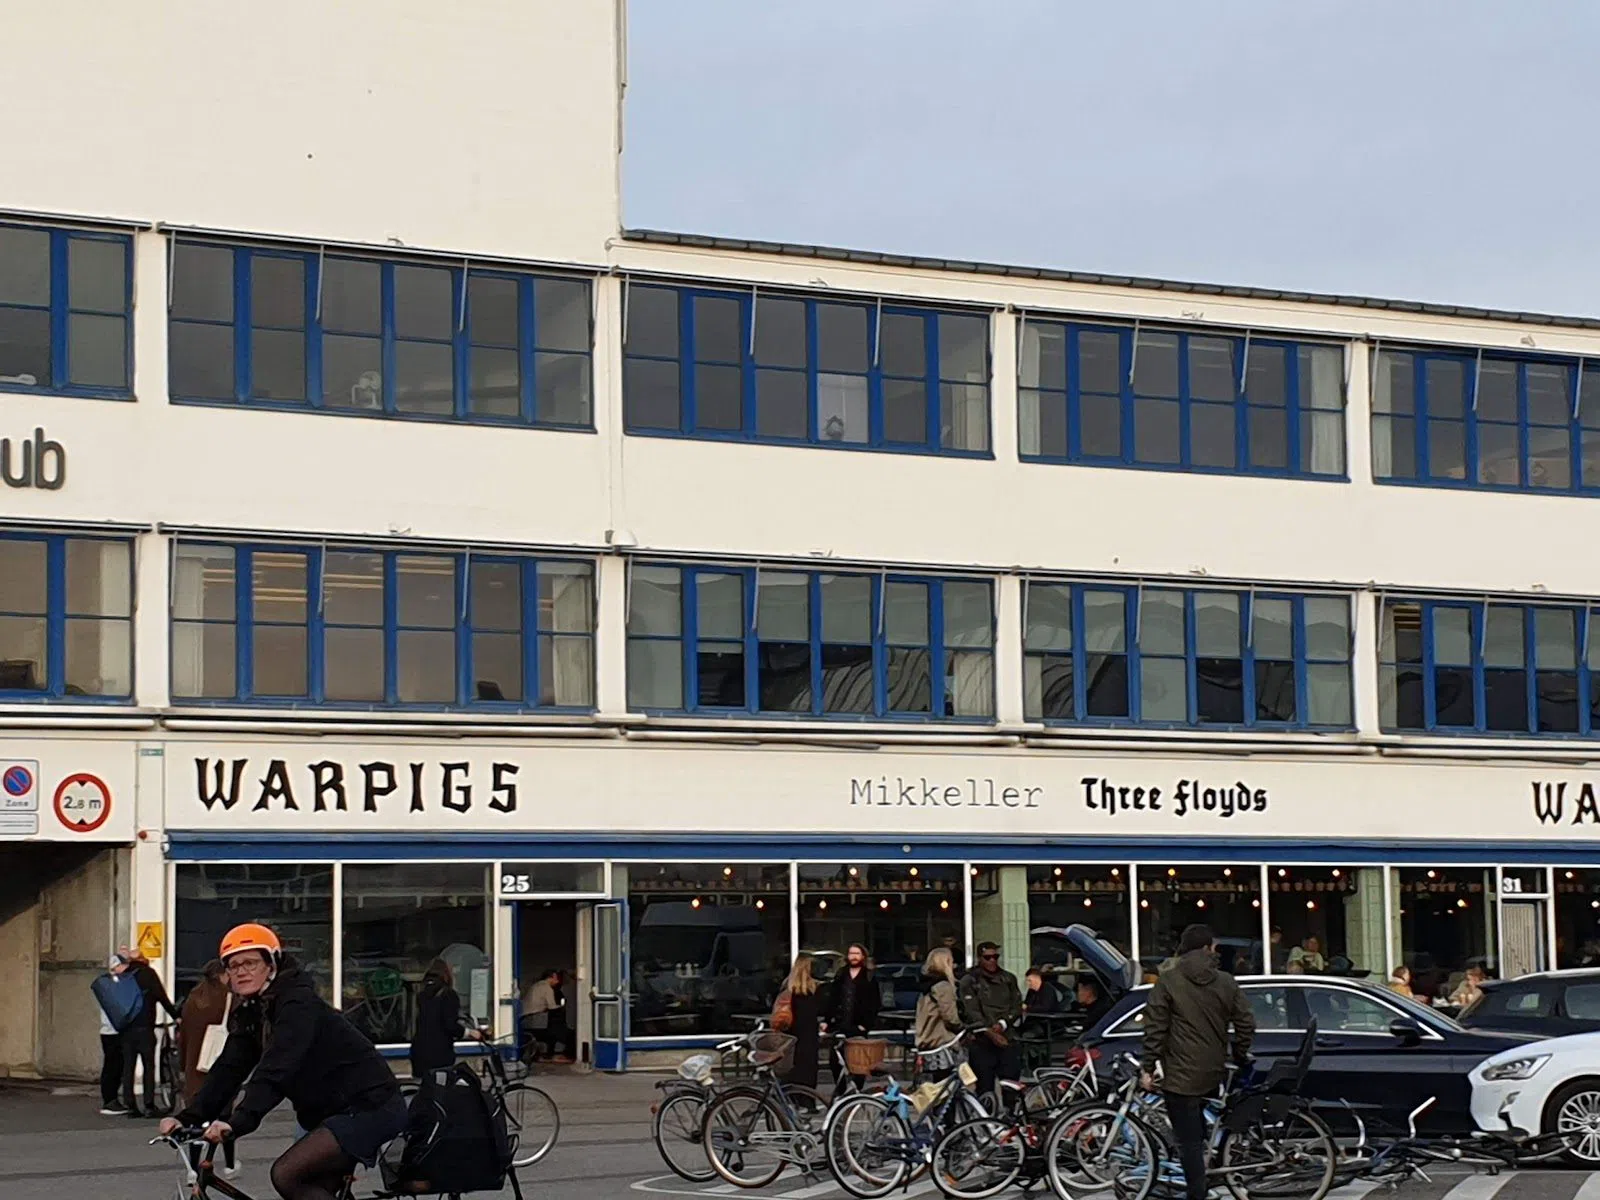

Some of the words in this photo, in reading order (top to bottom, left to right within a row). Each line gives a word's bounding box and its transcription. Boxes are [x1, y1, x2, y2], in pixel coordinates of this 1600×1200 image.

[194, 757, 519, 814] WARPIGS
[850, 776, 1043, 807] Mikkeller
[1080, 777, 1162, 816] Three
[1531, 781, 1600, 825] WA
[502, 874, 530, 892] 25
[1502, 877, 1522, 892] 31
